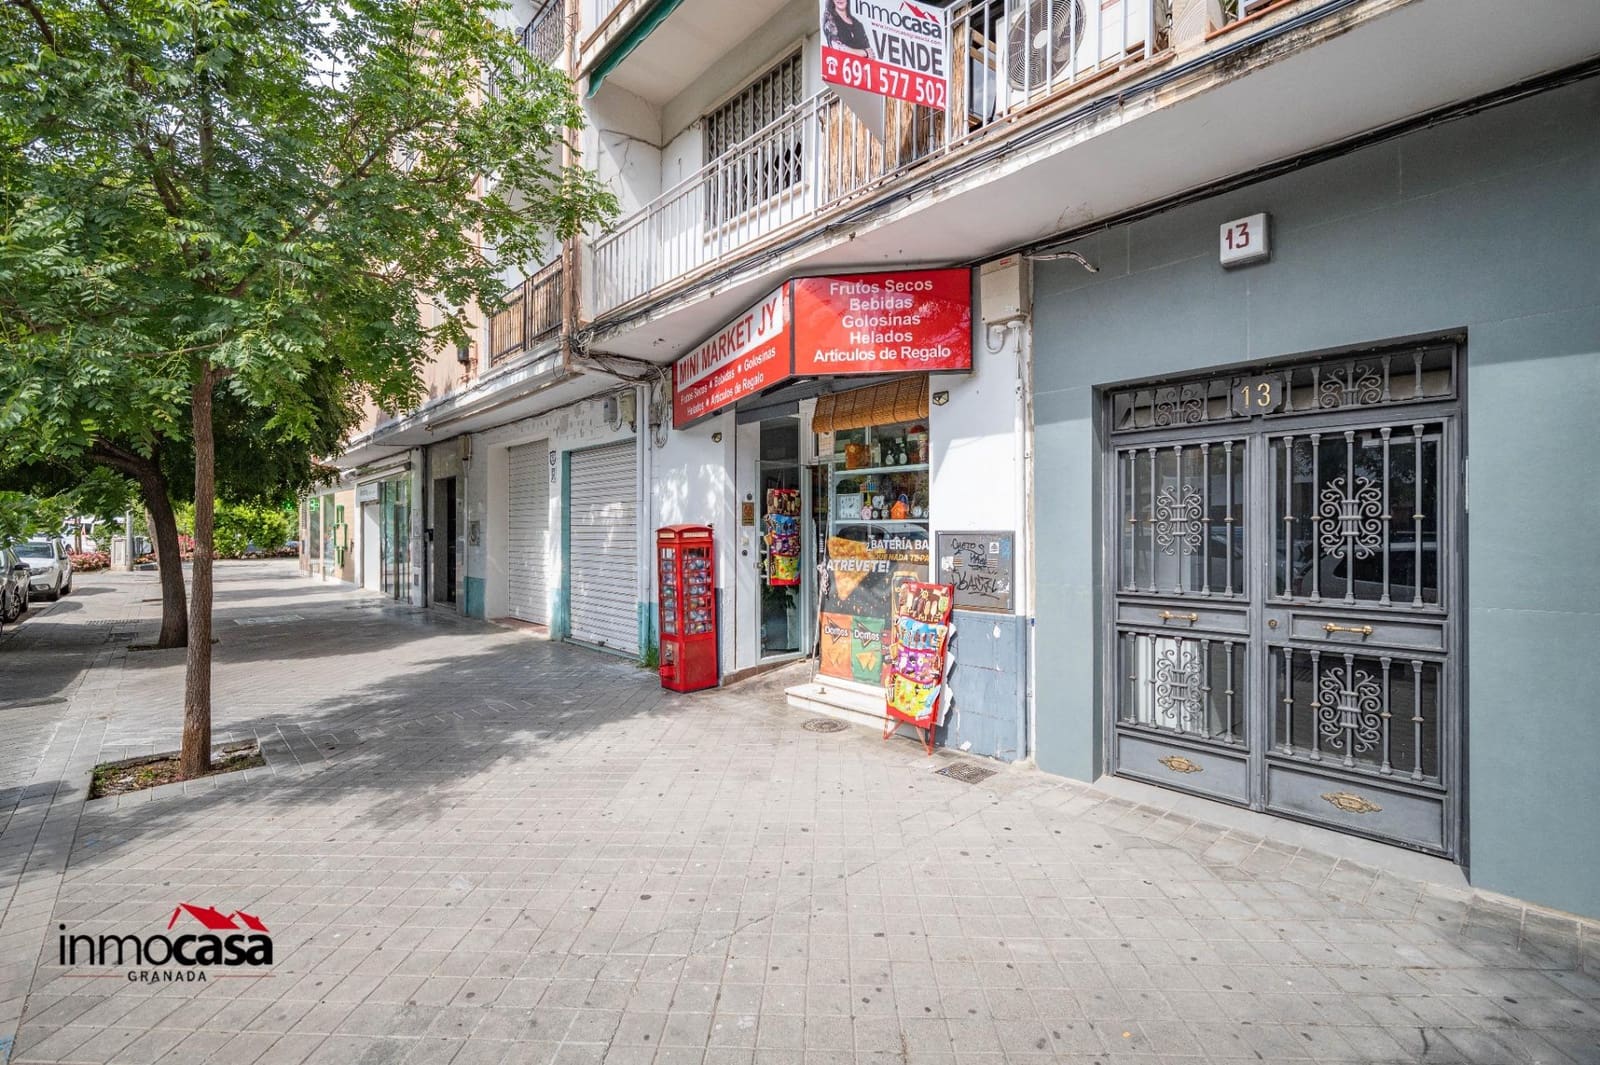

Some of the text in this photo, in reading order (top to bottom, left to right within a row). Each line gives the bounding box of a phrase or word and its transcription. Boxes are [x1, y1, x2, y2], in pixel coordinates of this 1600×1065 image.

[856, 0, 942, 39] inmocasa
[872, 30, 943, 76] VENDE
[843, 57, 945, 107] 691 577 502
[1225, 222, 1250, 250] 13
[830, 280, 933, 296] Frutos Secos
[850, 297, 913, 311] Bebidas
[842, 312, 921, 328] Golosinas
[679, 297, 777, 385] MINI MARKET JY
[850, 331, 913, 345] Helados
[879, 347, 897, 359] de
[901, 345, 951, 361] Regalo
[714, 369, 735, 387] Bebidas
[744, 348, 776, 371] Golosinas
[734, 382, 742, 394] de
[743, 371, 764, 391] Regalo
[1241, 383, 1271, 409] 13
